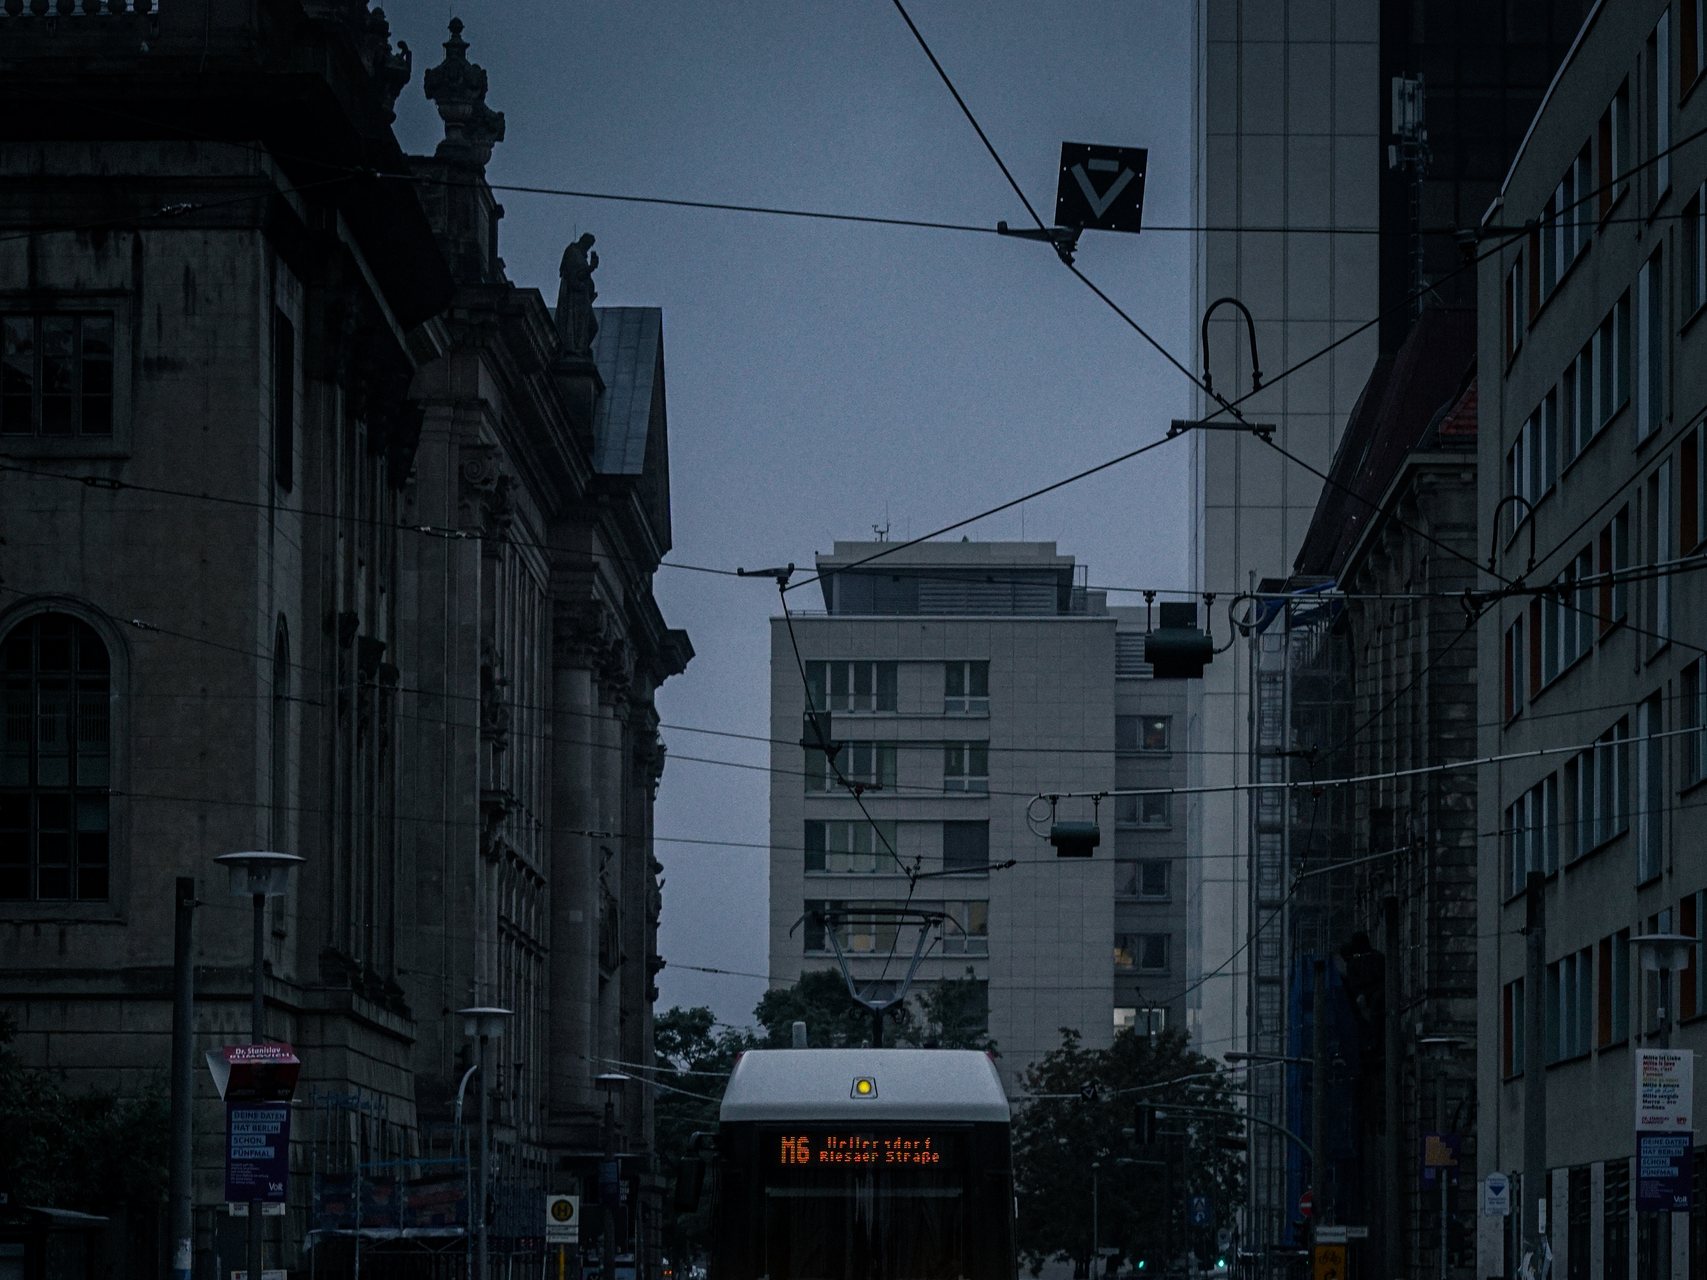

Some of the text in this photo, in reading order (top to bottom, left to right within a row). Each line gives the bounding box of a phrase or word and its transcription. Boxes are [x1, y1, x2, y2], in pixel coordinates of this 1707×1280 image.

[235, 1046, 281, 1056] Dr. Stanislav
[781, 1136, 810, 1164] M6
[820, 1151, 940, 1164] Riesaer Straße
